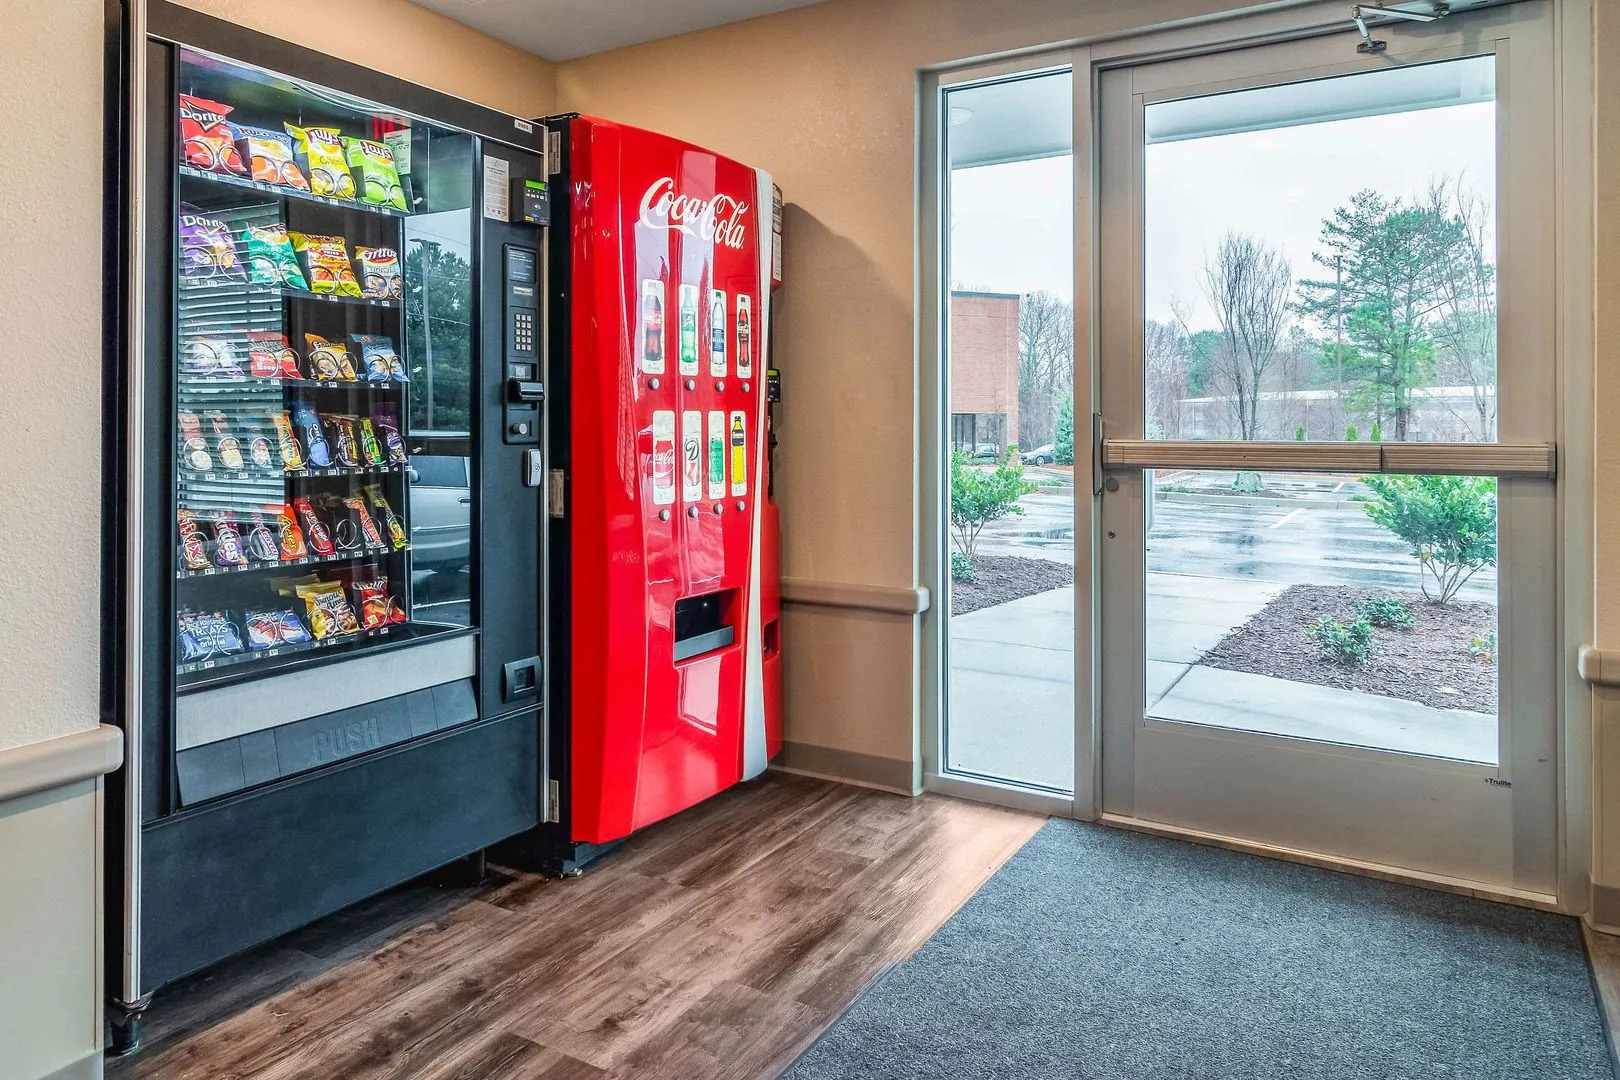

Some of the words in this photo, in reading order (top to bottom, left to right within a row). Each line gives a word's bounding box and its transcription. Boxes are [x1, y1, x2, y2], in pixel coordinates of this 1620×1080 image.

[639, 176, 750, 250] Coca-Cola
[190, 624, 229, 637] TREATS
[313, 717, 381, 761] PUSH
[1488, 777, 1512, 788] Trulite
